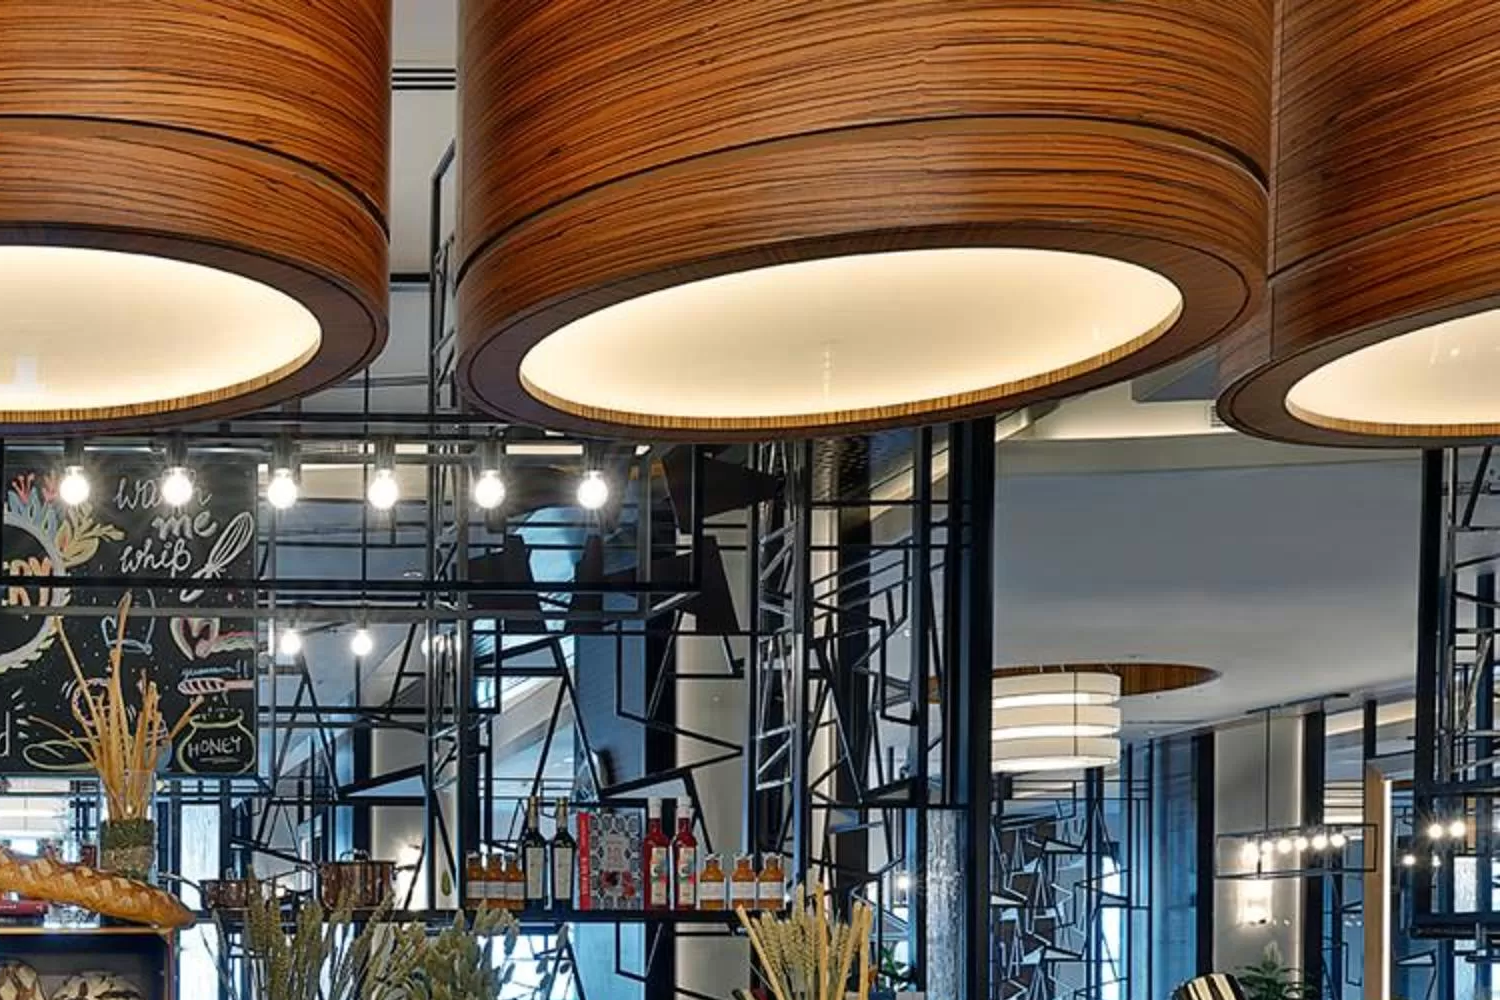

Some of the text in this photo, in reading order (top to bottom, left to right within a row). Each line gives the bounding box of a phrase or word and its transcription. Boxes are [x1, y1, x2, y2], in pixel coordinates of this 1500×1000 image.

[152, 511, 217, 540] me
[120, 538, 192, 579] whip
[188, 735, 242, 758] HONEY
